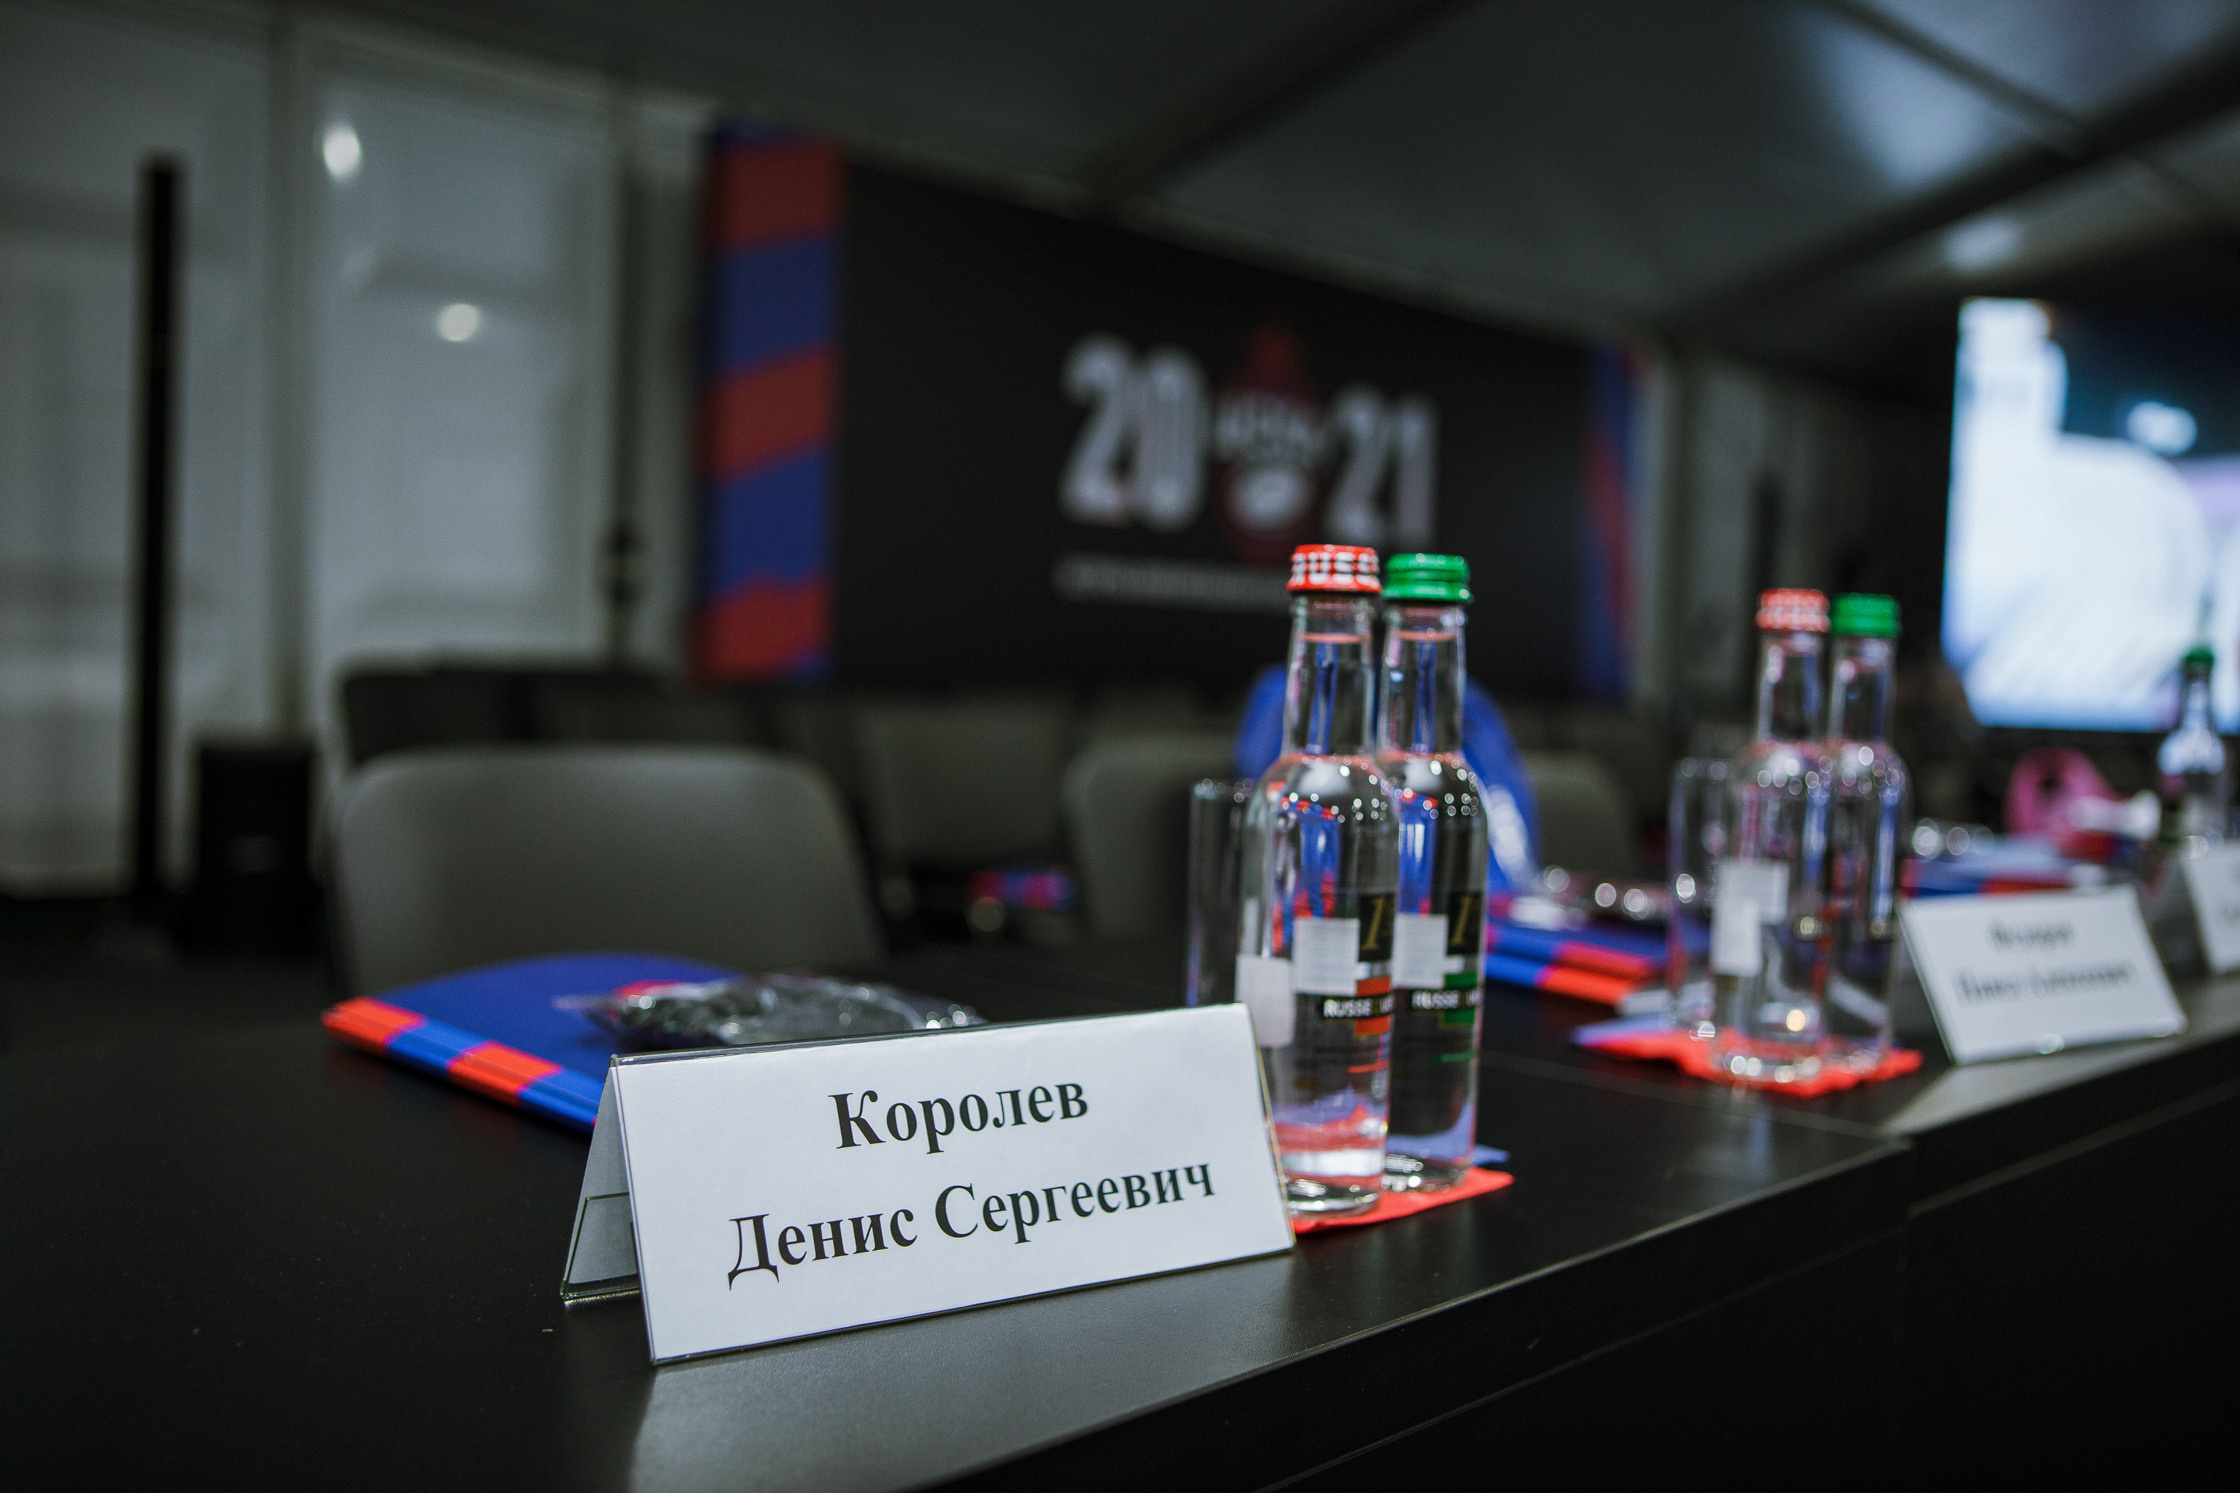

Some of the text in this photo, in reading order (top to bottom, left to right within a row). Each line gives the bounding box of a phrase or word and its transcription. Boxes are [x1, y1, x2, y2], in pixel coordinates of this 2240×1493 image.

[1063, 336, 1438, 549] 20 21
[829, 1082, 1089, 1154] Королев
[727, 1162, 1216, 1291] Денис Сергеевич
